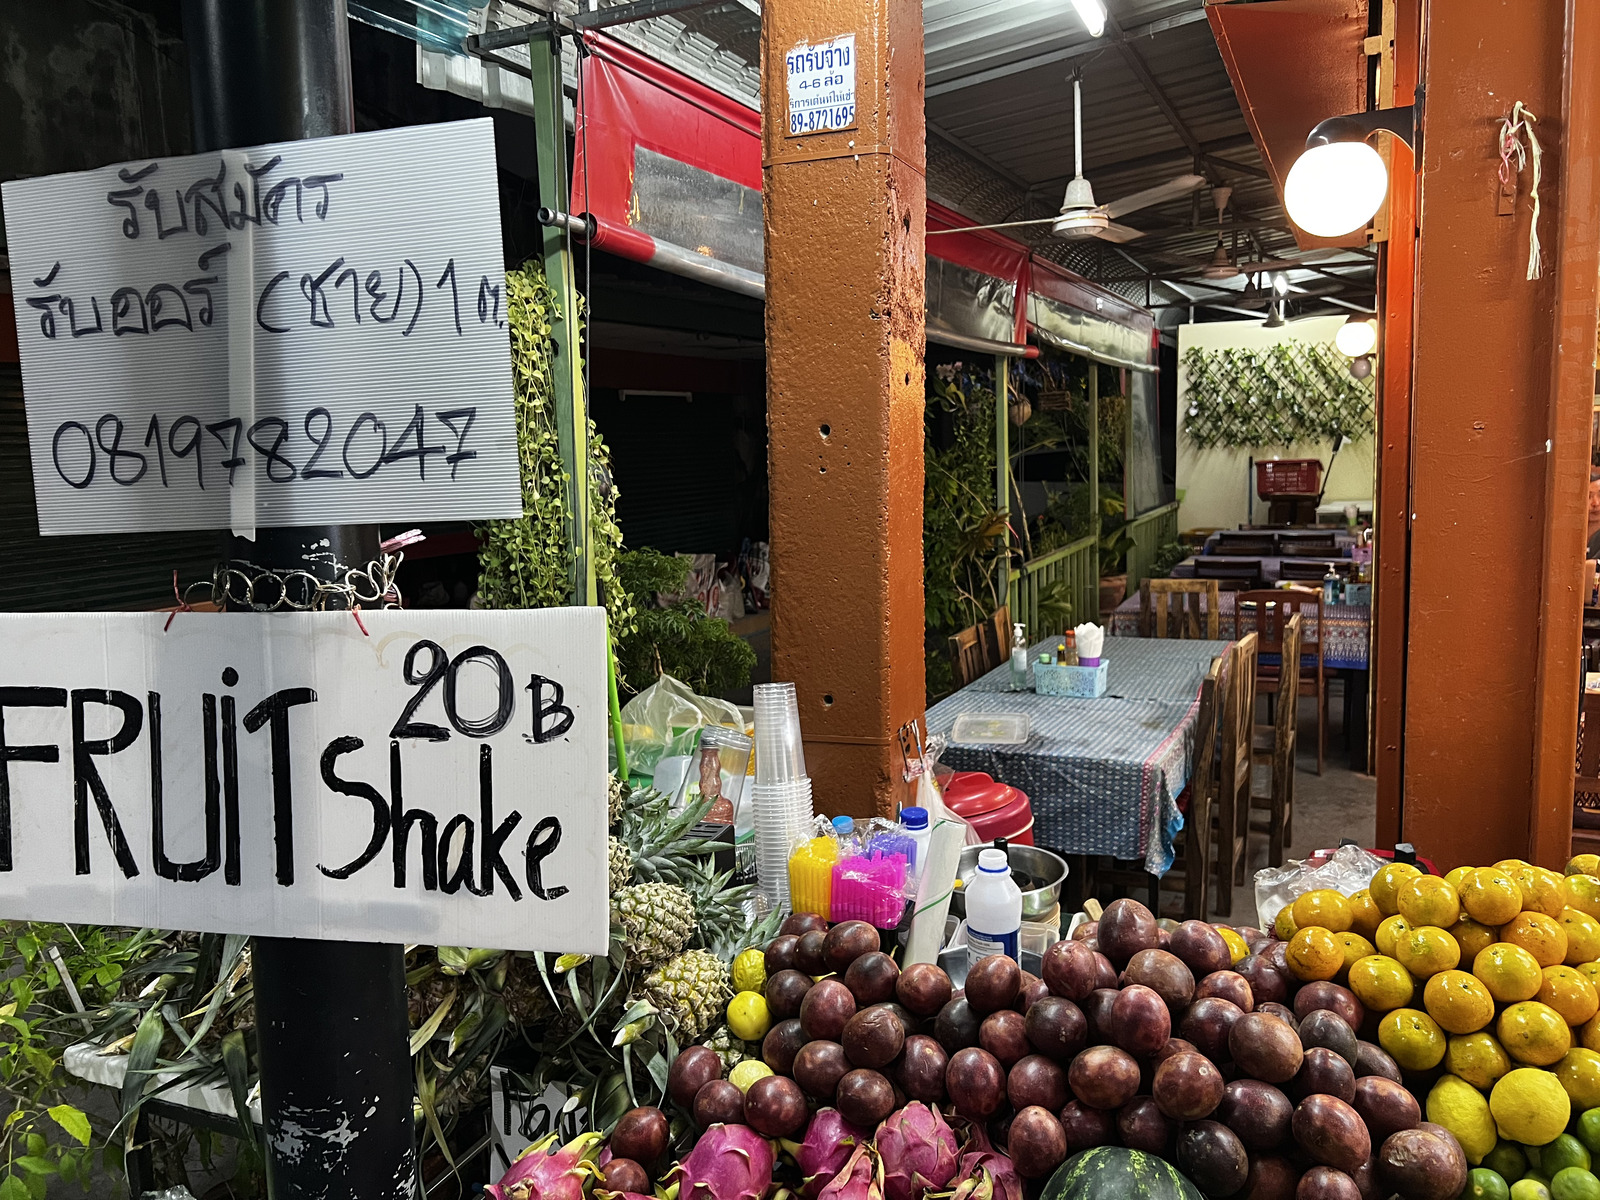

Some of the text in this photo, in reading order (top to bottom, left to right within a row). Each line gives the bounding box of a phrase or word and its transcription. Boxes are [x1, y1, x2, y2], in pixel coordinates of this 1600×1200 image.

[791, 105, 855, 133] 89-8721695
[824, 70, 843, 86] ล้อ
[107, 155, 343, 240] รับสมัคร
[52, 404, 476, 490] 0819782047
[316, 736, 570, 901] Shake
